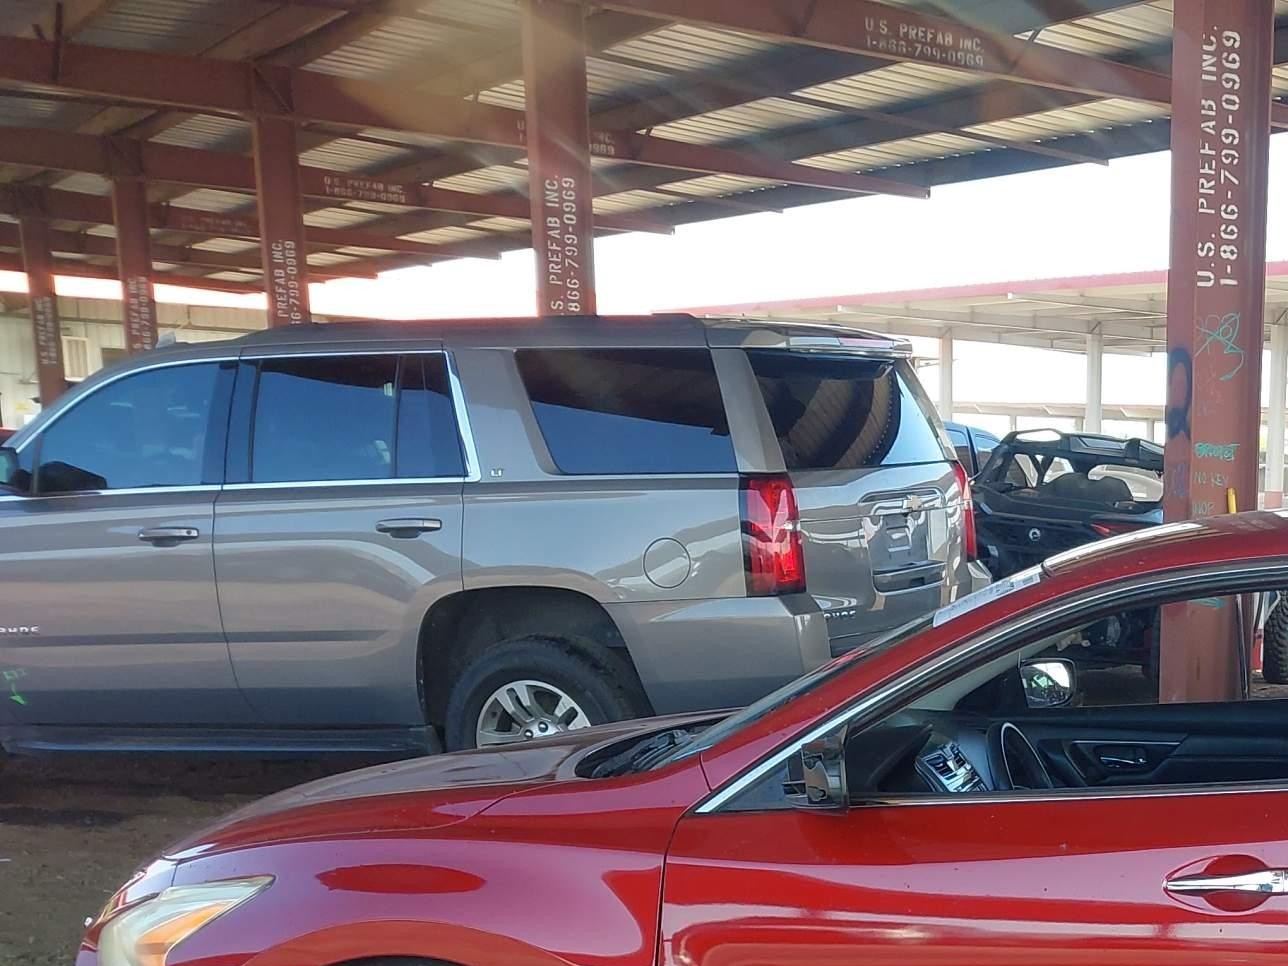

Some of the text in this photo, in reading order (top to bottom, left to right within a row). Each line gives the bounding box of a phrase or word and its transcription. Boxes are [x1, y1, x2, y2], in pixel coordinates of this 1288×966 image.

[899, 23, 953, 47] PREFAB
[959, 37, 985, 53] INC.
[544, 174, 560, 207] INC.
[1197, 25, 1218, 287] U.S. PREFAB INC.
[1220, 30, 1241, 286] 1-866-799-0969
[272, 240, 289, 317] PREFAB INC.
[547, 216, 563, 285] PREFAB
[561, 177, 580, 312] 866-799-0969
